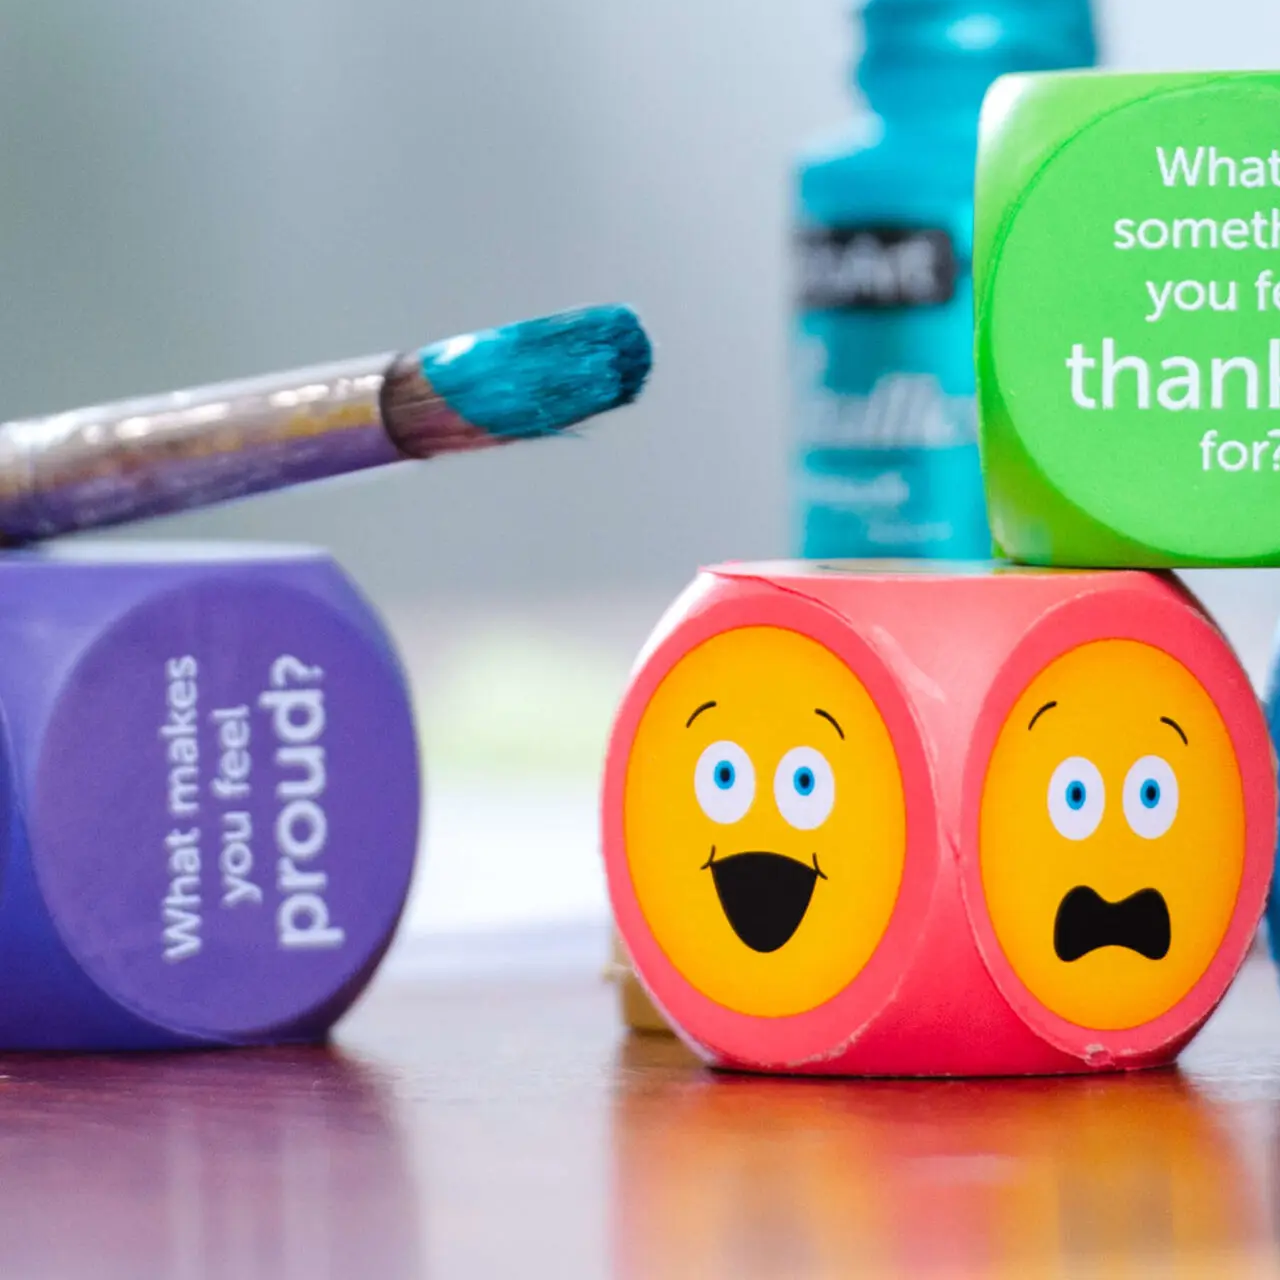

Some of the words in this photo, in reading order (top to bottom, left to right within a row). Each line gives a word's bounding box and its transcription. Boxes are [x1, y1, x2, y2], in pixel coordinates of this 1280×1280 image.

[1143, 278, 1239, 323] you
[160, 653, 200, 816] makes
[211, 704, 252, 798] feel
[220, 810, 263, 906] you
[258, 653, 346, 949] proud?
[162, 826, 203, 961] What
